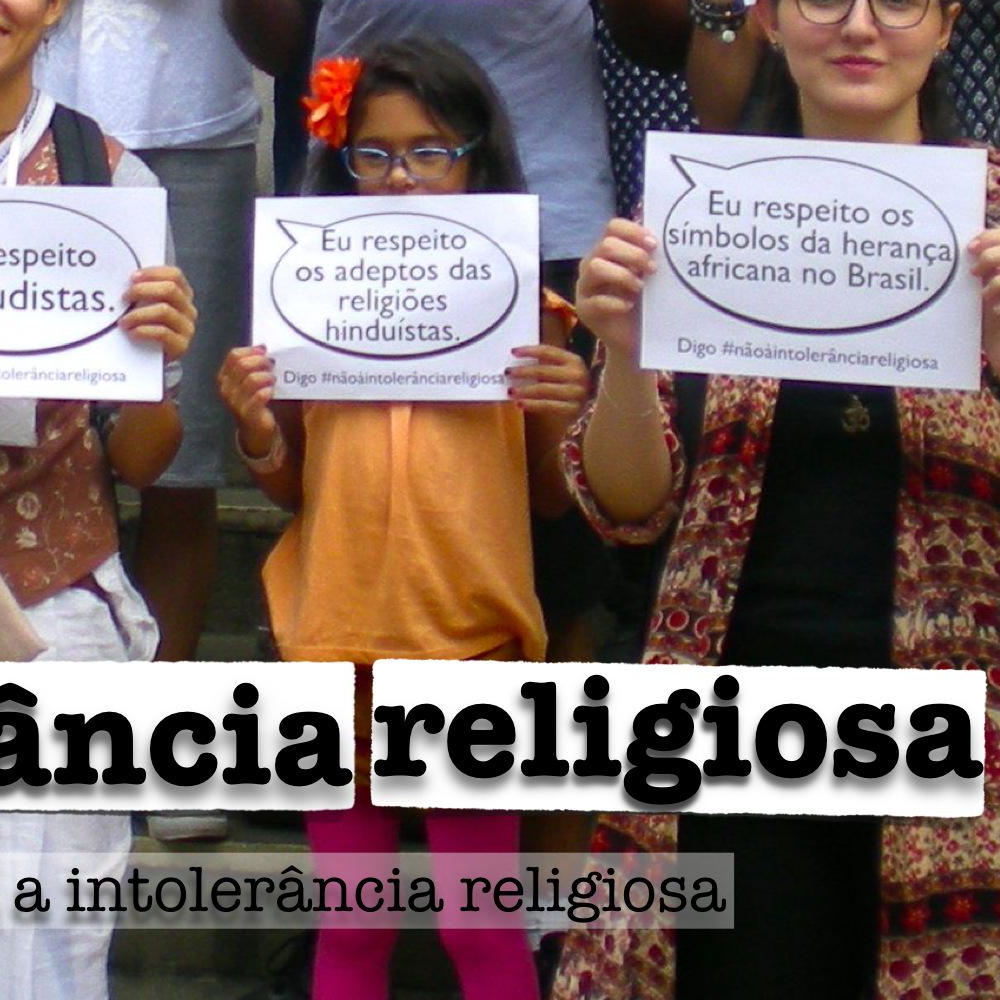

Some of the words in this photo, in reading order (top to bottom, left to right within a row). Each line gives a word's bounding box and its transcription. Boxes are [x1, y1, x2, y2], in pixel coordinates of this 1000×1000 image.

[708, 189, 741, 217] Eu
[753, 198, 870, 229] respeito
[881, 207, 914, 228] os
[322, 229, 352, 252] Eu
[362, 228, 467, 258] respeito
[668, 220, 790, 252] símbolos
[801, 229, 831, 255] da
[843, 231, 952, 267] herança
[295, 264, 325, 282] os
[335, 258, 439, 288] adeptos
[449, 257, 492, 281] das
[687, 255, 791, 284] africana
[802, 266, 836, 287] no
[848, 262, 930, 292] Brasil.
[338, 288, 448, 320] religiões
[326, 317, 461, 342] hinduístas.
[677, 337, 717, 360] Digo
[283, 370, 317, 388] Digo
